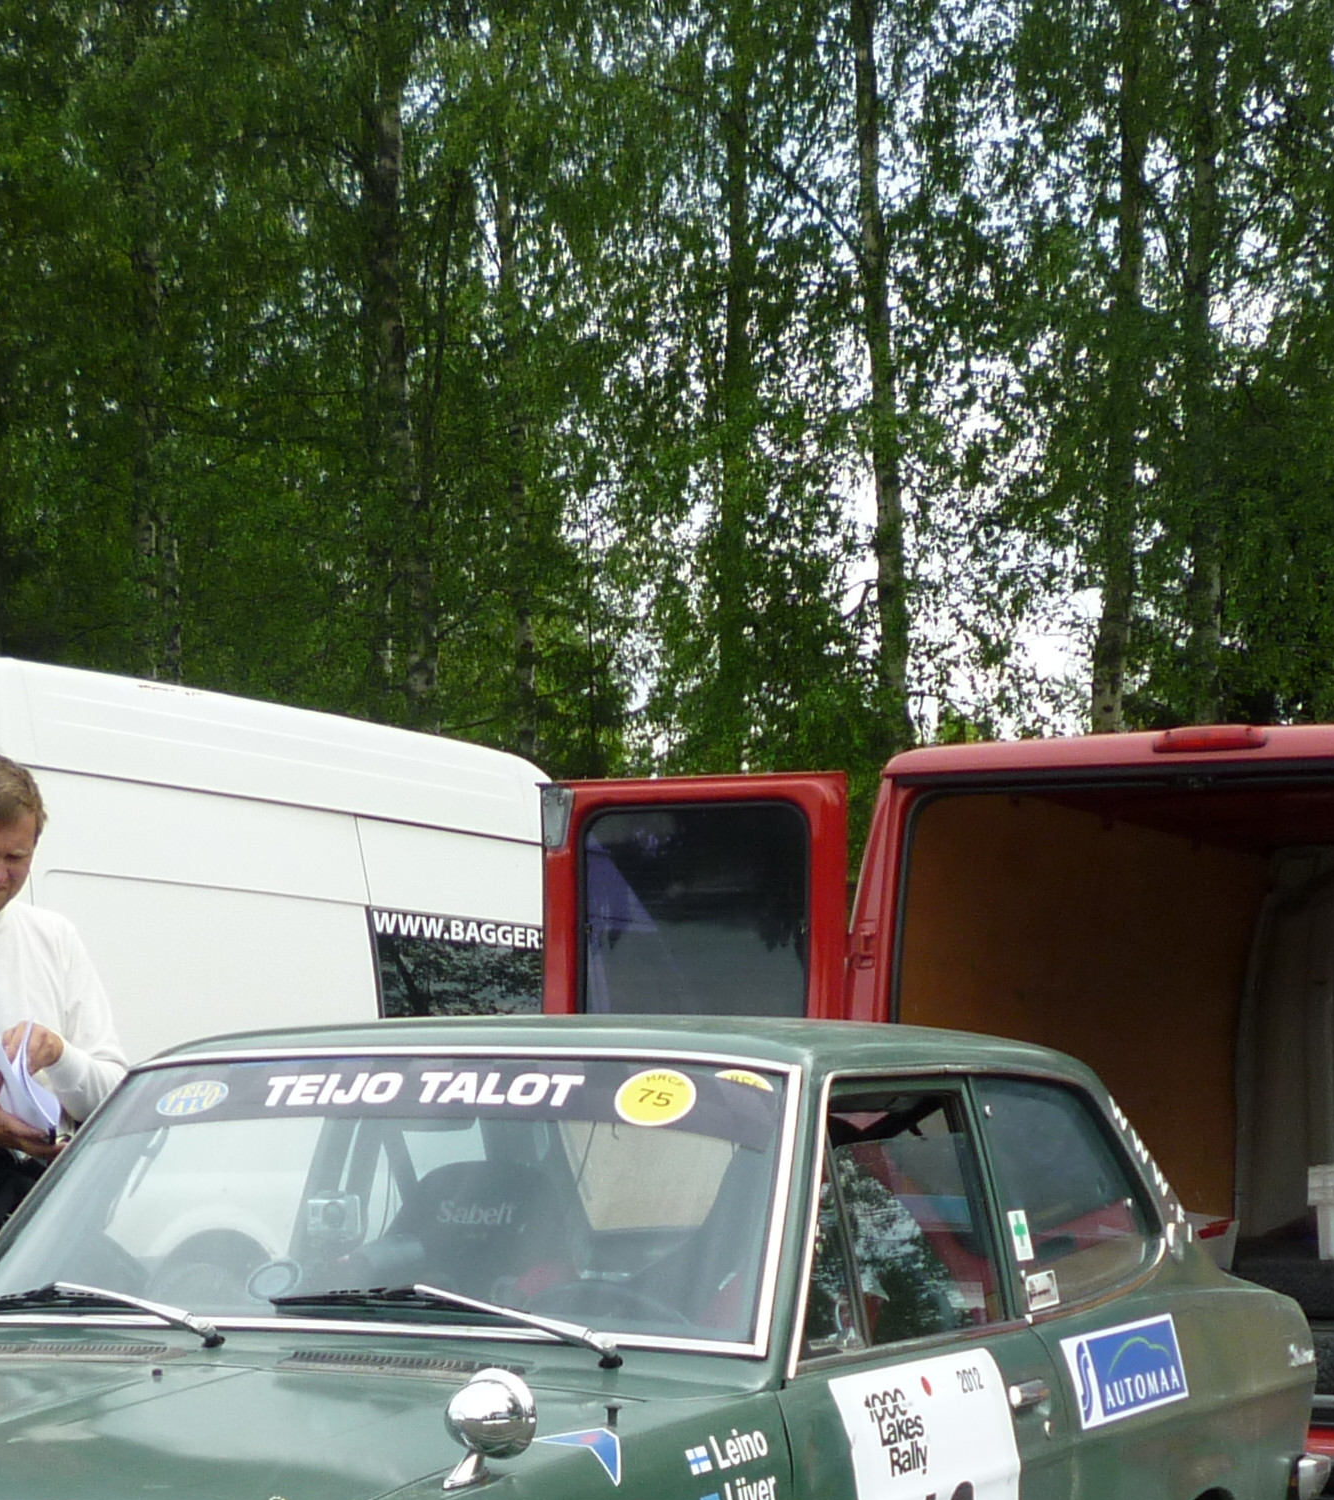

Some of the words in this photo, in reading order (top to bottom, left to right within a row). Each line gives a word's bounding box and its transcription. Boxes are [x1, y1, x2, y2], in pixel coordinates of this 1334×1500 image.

[372, 911, 543, 949] WWW.BAGGER
[264, 1072, 403, 1106] TEIJO
[419, 1072, 585, 1106] TALOT
[638, 1088, 673, 1107] 75
[956, 1367, 984, 1393] 2012
[1105, 1365, 1180, 1410] AUTOMAA
[865, 1388, 908, 1423] 1000
[709, 1428, 768, 1469] Leino
[879, 1415, 925, 1447] Lakes
[889, 1440, 928, 1478] Rally
